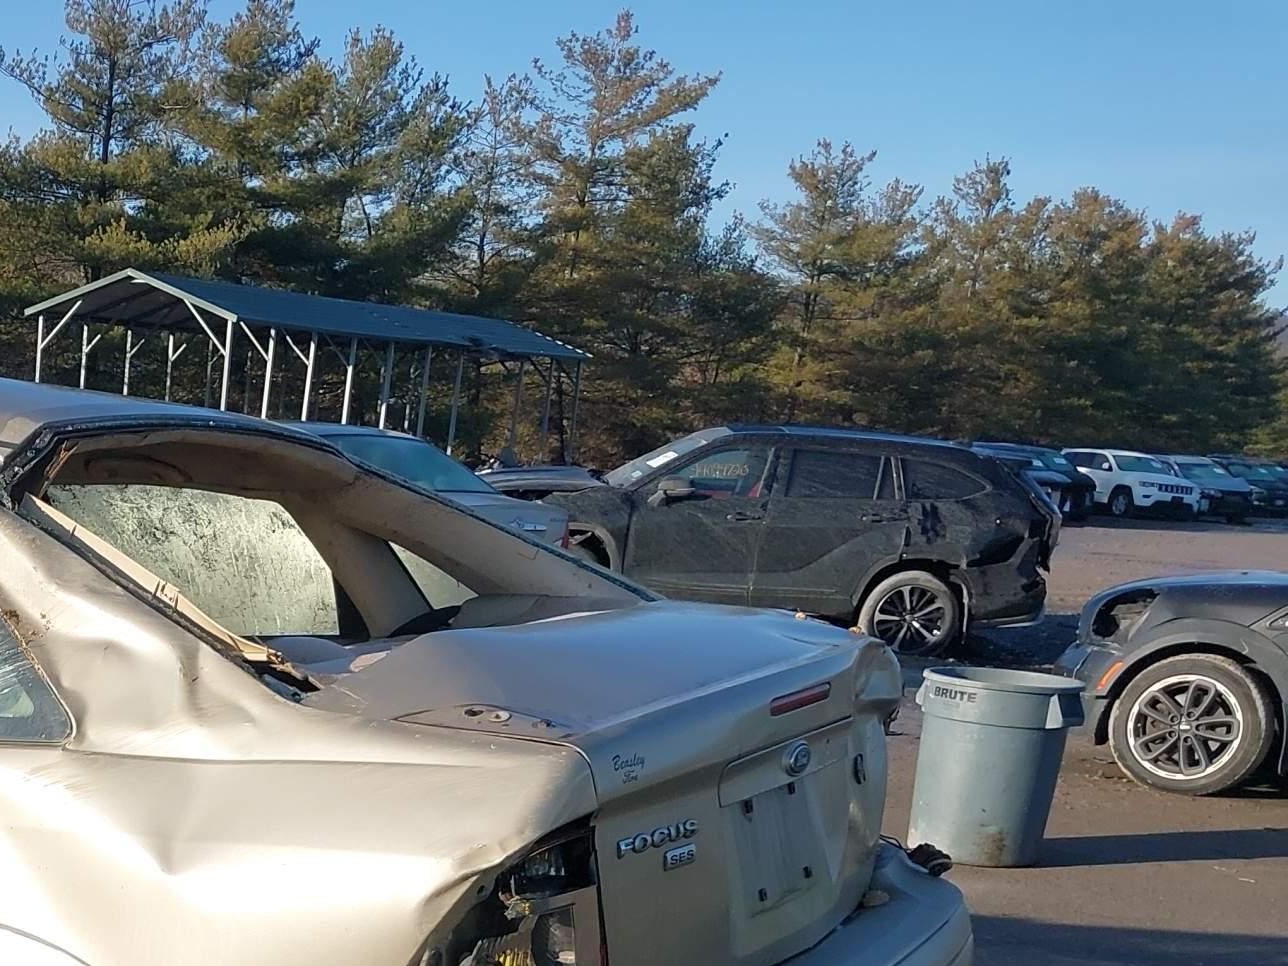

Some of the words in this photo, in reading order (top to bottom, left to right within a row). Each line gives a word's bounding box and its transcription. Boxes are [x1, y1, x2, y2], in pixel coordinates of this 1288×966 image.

[934, 686, 977, 703] BRUTE
[616, 818, 698, 860] FOCUS
[669, 849, 695, 866] SES
